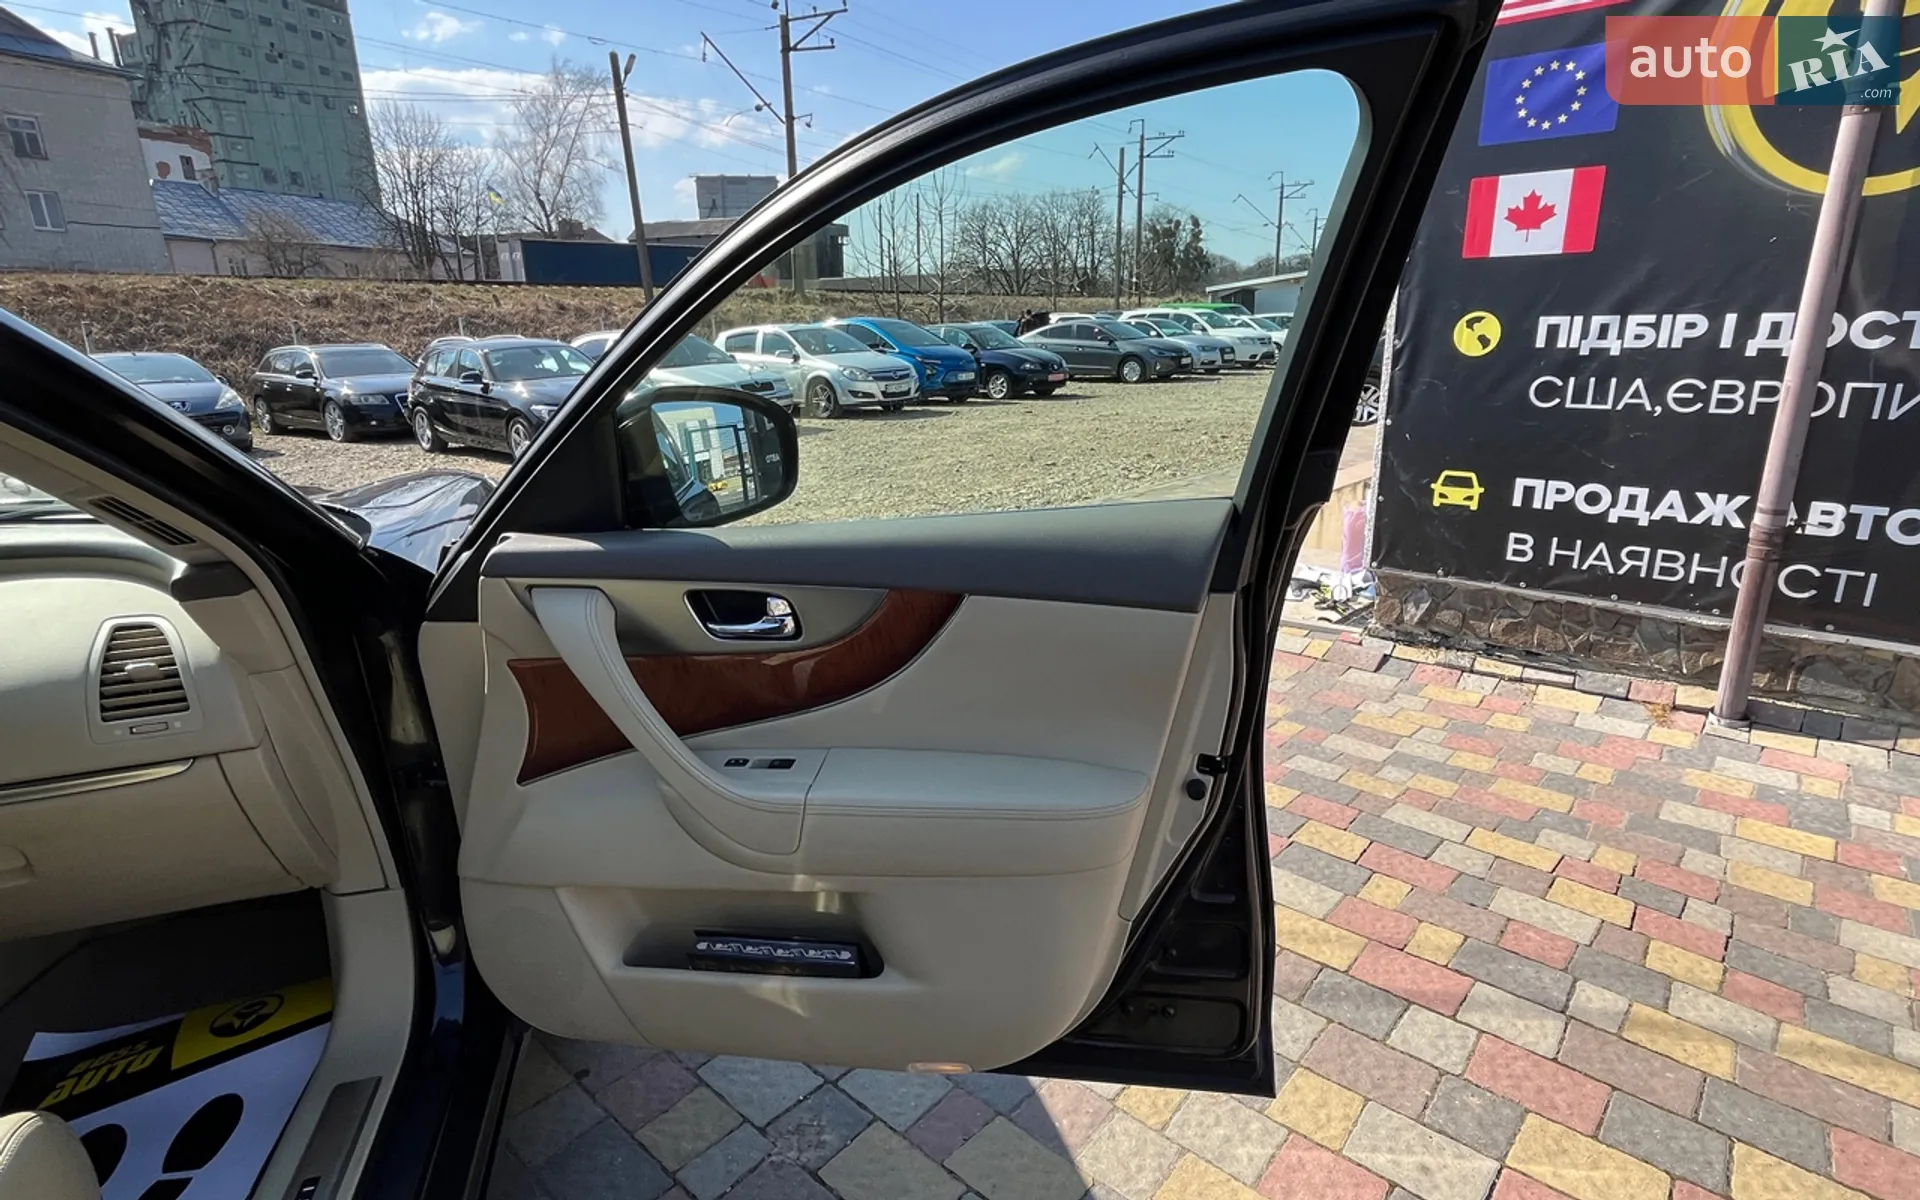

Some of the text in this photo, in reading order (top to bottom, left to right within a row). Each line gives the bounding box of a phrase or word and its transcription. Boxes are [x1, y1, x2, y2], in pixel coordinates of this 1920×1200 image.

[1535, 313, 1709, 356] ПІДБІР
[1719, 313, 1738, 348] І
[1512, 477, 1751, 527] ПРОДАЖ
[1505, 532, 1535, 562] В
